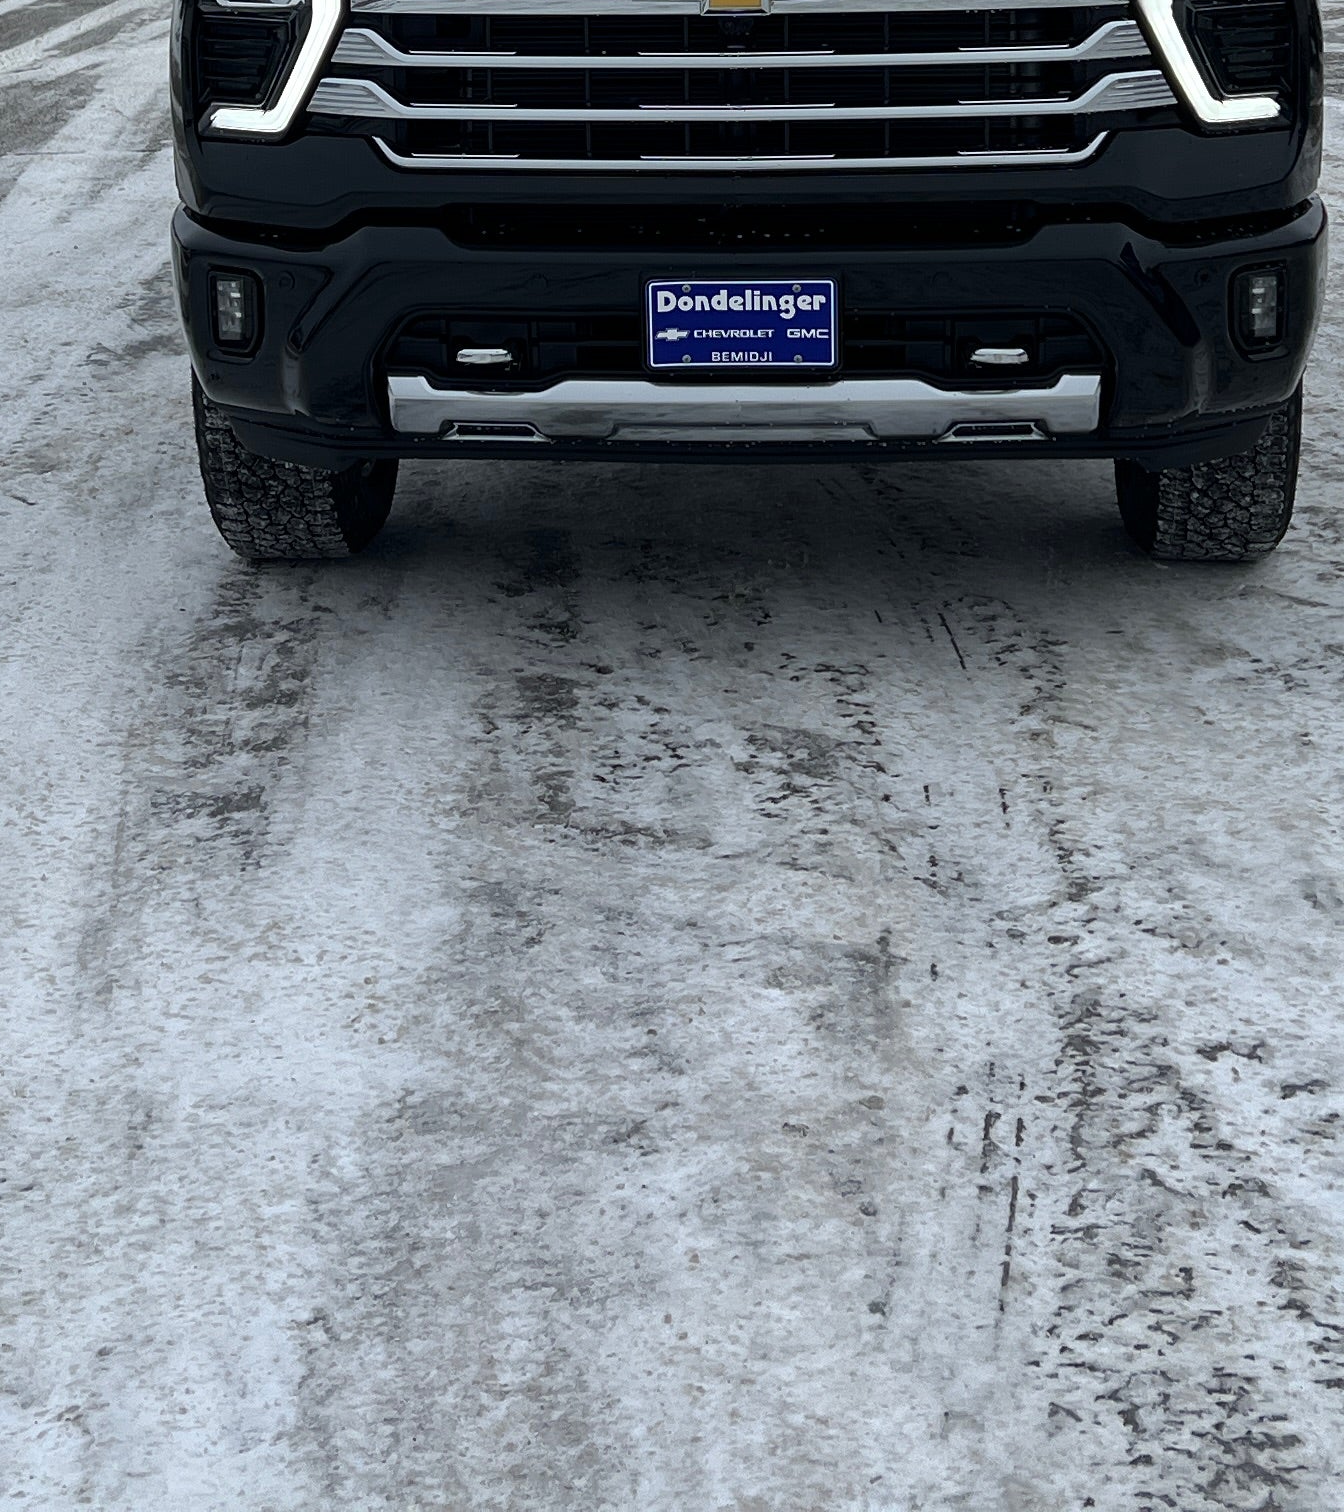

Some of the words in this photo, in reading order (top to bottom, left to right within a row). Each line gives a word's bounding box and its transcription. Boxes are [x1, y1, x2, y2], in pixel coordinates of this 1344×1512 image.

[657, 289, 827, 319] Dondelinger
[693, 329, 775, 338] CHEVROLET
[786, 328, 829, 338] GMC
[711, 351, 773, 362] BEMIDJI
